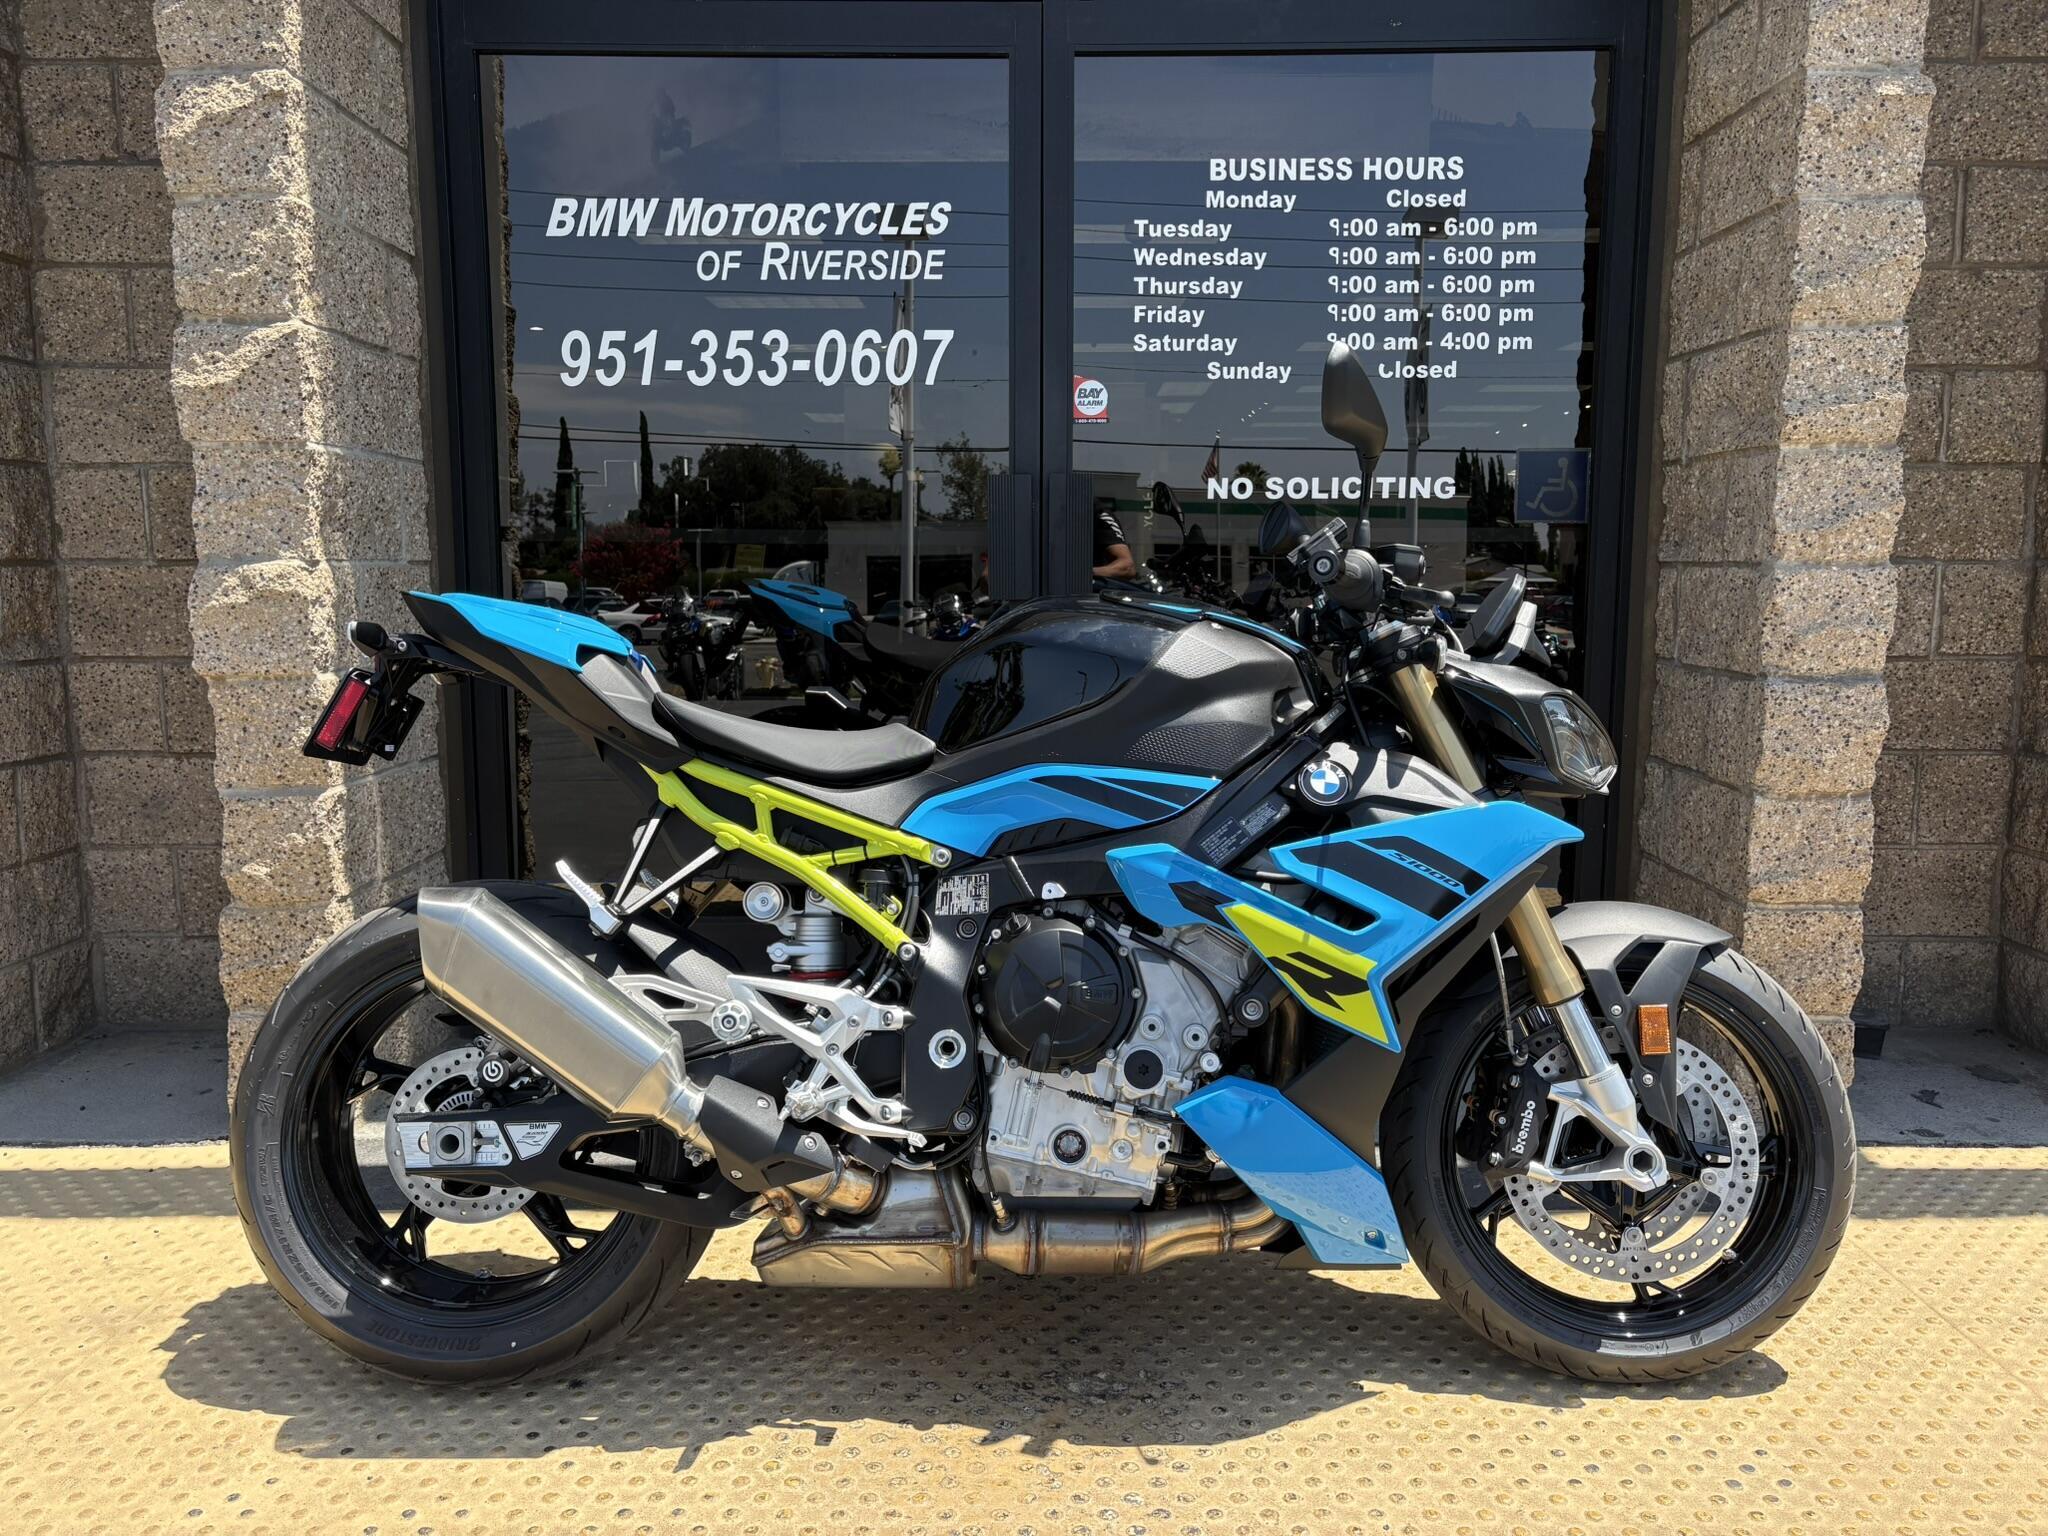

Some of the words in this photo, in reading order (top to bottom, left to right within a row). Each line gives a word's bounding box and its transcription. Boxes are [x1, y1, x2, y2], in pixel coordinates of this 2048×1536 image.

[1209, 157, 1353, 182] BUSINESS
[1363, 155, 1464, 181] HOURS
[1206, 190, 1297, 213] Monday
[1386, 188, 1467, 208] Closed
[545, 197, 660, 237] BMW
[664, 197, 952, 237] MOTORCYCLES
[1133, 218, 1233, 242] Tuesday
[1385, 222, 1421, 237] am
[1444, 216, 1494, 237] 6:00
[1502, 221, 1538, 241] pm
[696, 250, 743, 281] OF
[760, 241, 946, 281] RIVERSIDE
[1133, 247, 1268, 271] Wednesday
[1385, 251, 1421, 265] am
[1443, 246, 1493, 265] 6:00
[1501, 250, 1537, 269] pm
[1133, 276, 1244, 299] Thursday
[1384, 279, 1420, 294] am
[1442, 274, 1492, 294] 6:00
[1499, 279, 1535, 298] pm
[1133, 304, 1205, 328] Friday
[1383, 308, 1419, 322] am
[1441, 303, 1491, 322] 6:00
[1498, 307, 1534, 326] pm
[1132, 333, 1238, 356] Saturday
[1382, 336, 1418, 351] am
[1439, 331, 1490, 351] 4:00
[1497, 336, 1533, 355] pm
[559, 328, 955, 387] 951-353-0607
[1206, 361, 1292, 384] Sunday
[1378, 360, 1457, 379] Closed
[1077, 387, 1104, 399] BAY
[1077, 399, 1104, 407] ALARM
[1207, 477, 1254, 500] NO
[1387, 851, 1462, 889] S1000
[1511, 1100, 1537, 1155] brembo
